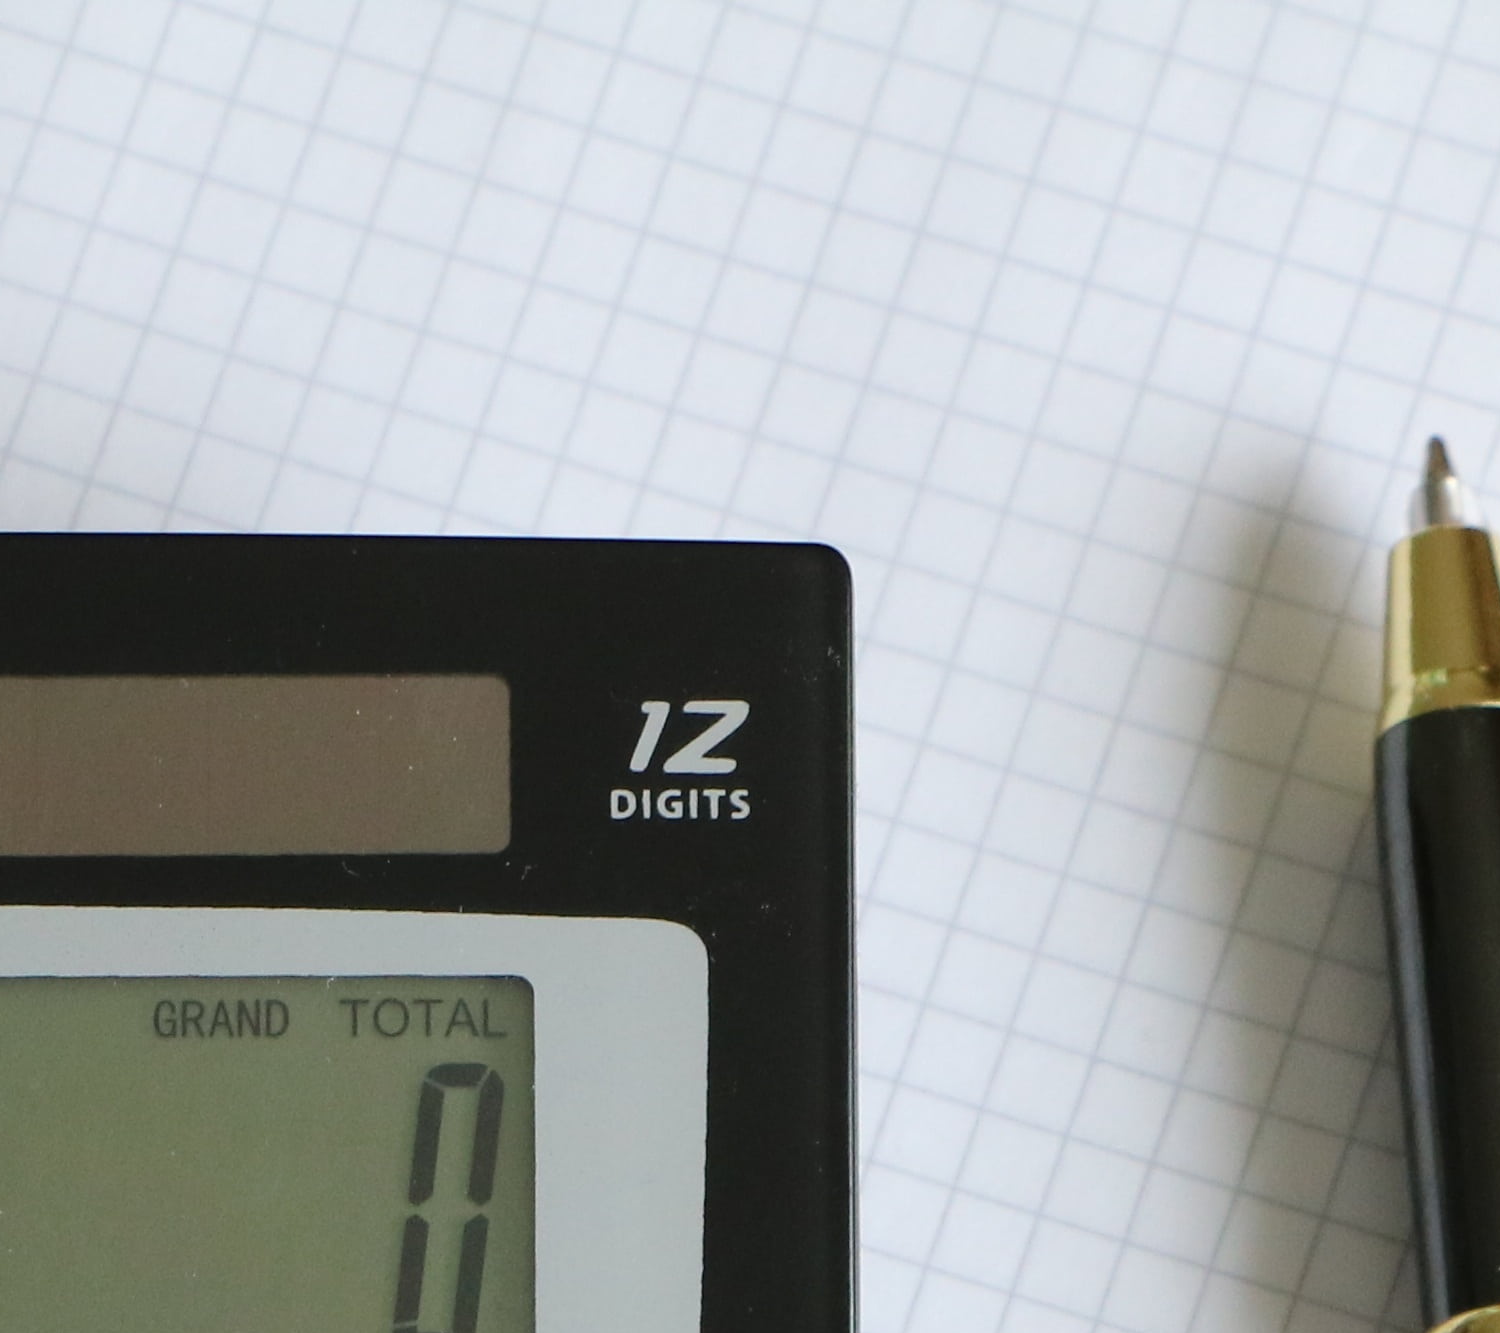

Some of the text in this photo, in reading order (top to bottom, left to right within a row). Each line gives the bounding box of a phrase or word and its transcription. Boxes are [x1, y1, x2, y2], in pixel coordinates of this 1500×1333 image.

[611, 788, 751, 820] DIGITS
[152, 998, 507, 1040] GRAND TOTAL
